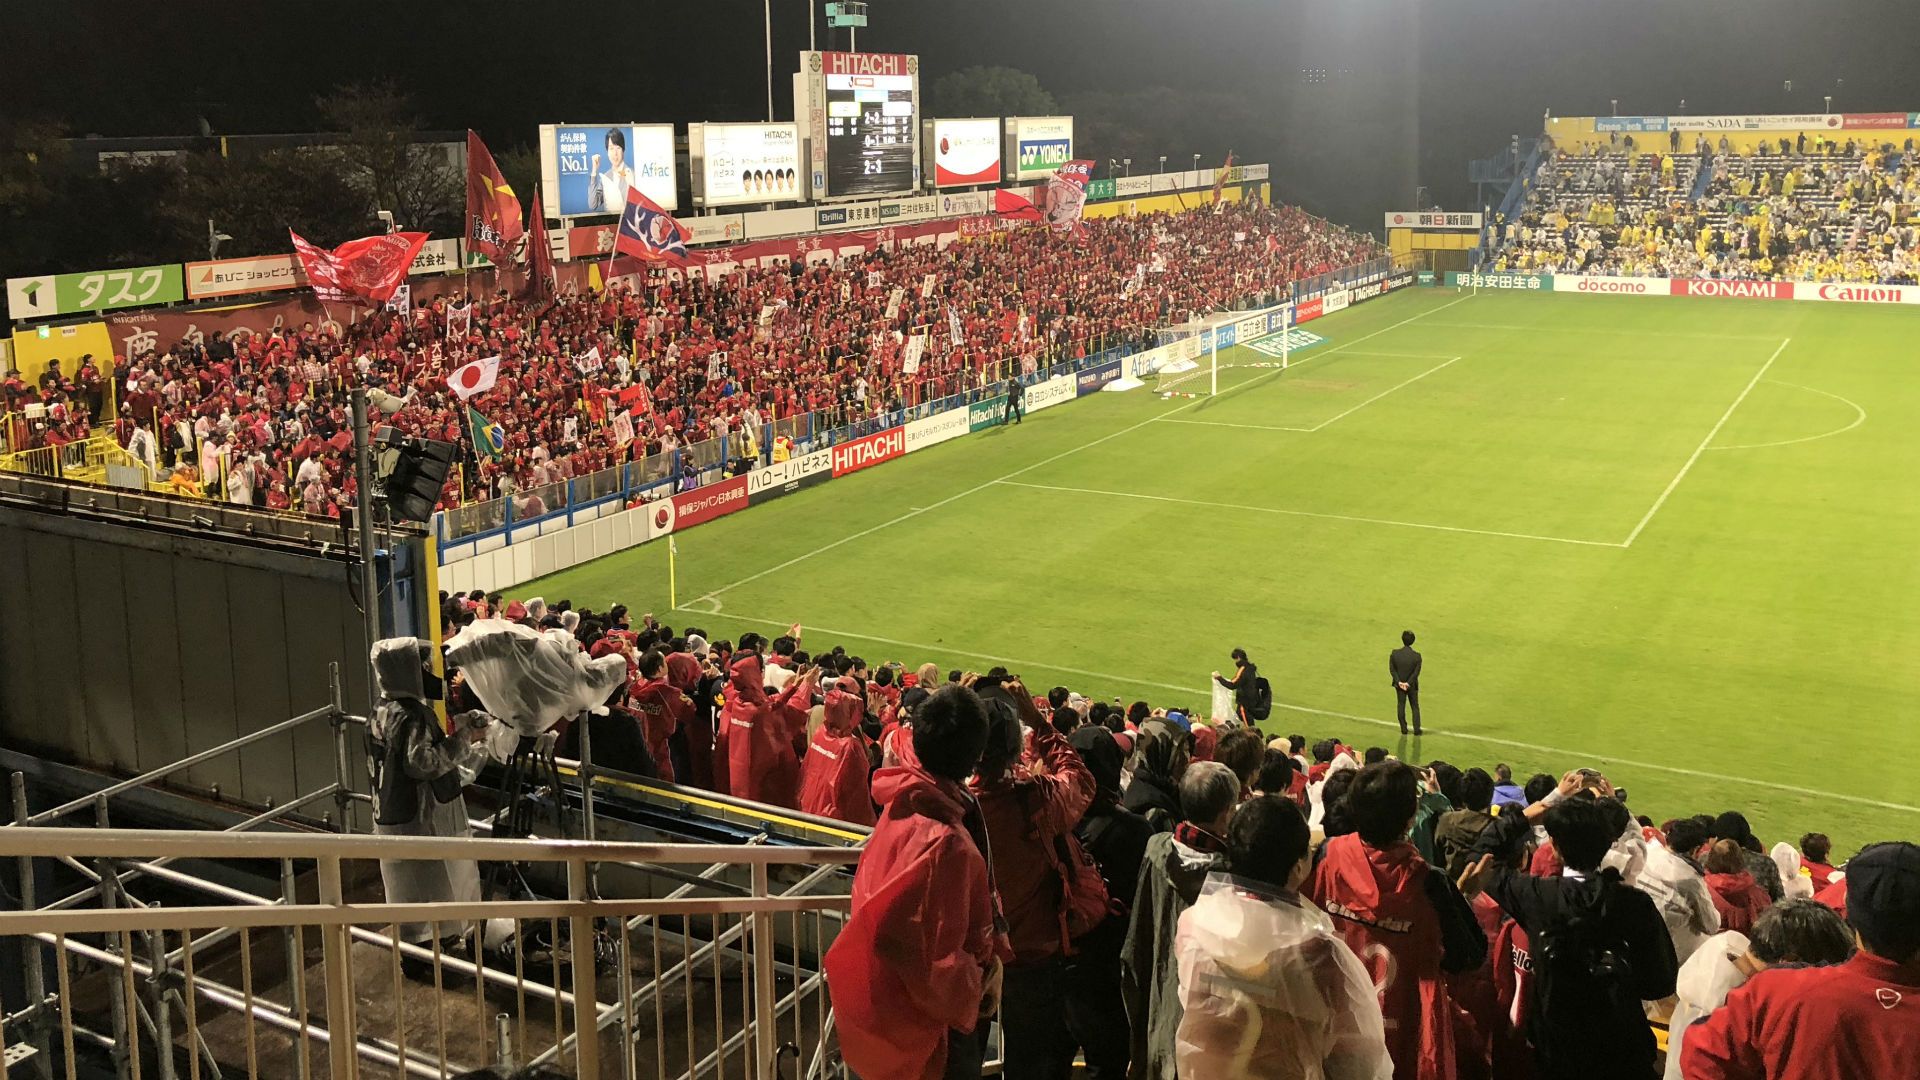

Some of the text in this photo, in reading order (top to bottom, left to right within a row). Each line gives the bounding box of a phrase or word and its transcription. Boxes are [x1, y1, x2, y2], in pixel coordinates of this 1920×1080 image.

[832, 54, 898, 75] HITACHI
[1706, 118, 1741, 128] SADA
[764, 131, 793, 139] HITACHI
[1039, 143, 1068, 165] YONEX
[561, 156, 589, 172] No.1
[641, 162, 670, 178] Aflac
[821, 207, 878, 222] Brillia 東京建物
[901, 203, 936, 217] 三井住友海上
[1419, 214, 1473, 226] 朝日新聞
[410, 252, 446, 268] 式会社
[78, 269, 163, 308] タスク
[1456, 273, 1542, 290] 明治安田生命
[1577, 277, 1646, 293] docomo
[1687, 280, 1777, 298] KONAMI
[1818, 284, 1902, 302] Canon
[1131, 355, 1156, 376] Aflac
[1034, 382, 1069, 404] 日立システムズ
[970, 404, 994, 425] Hitachi
[834, 433, 903, 472] HITACHI
[679, 486, 745, 518] 損保ジャパン日本興亜
